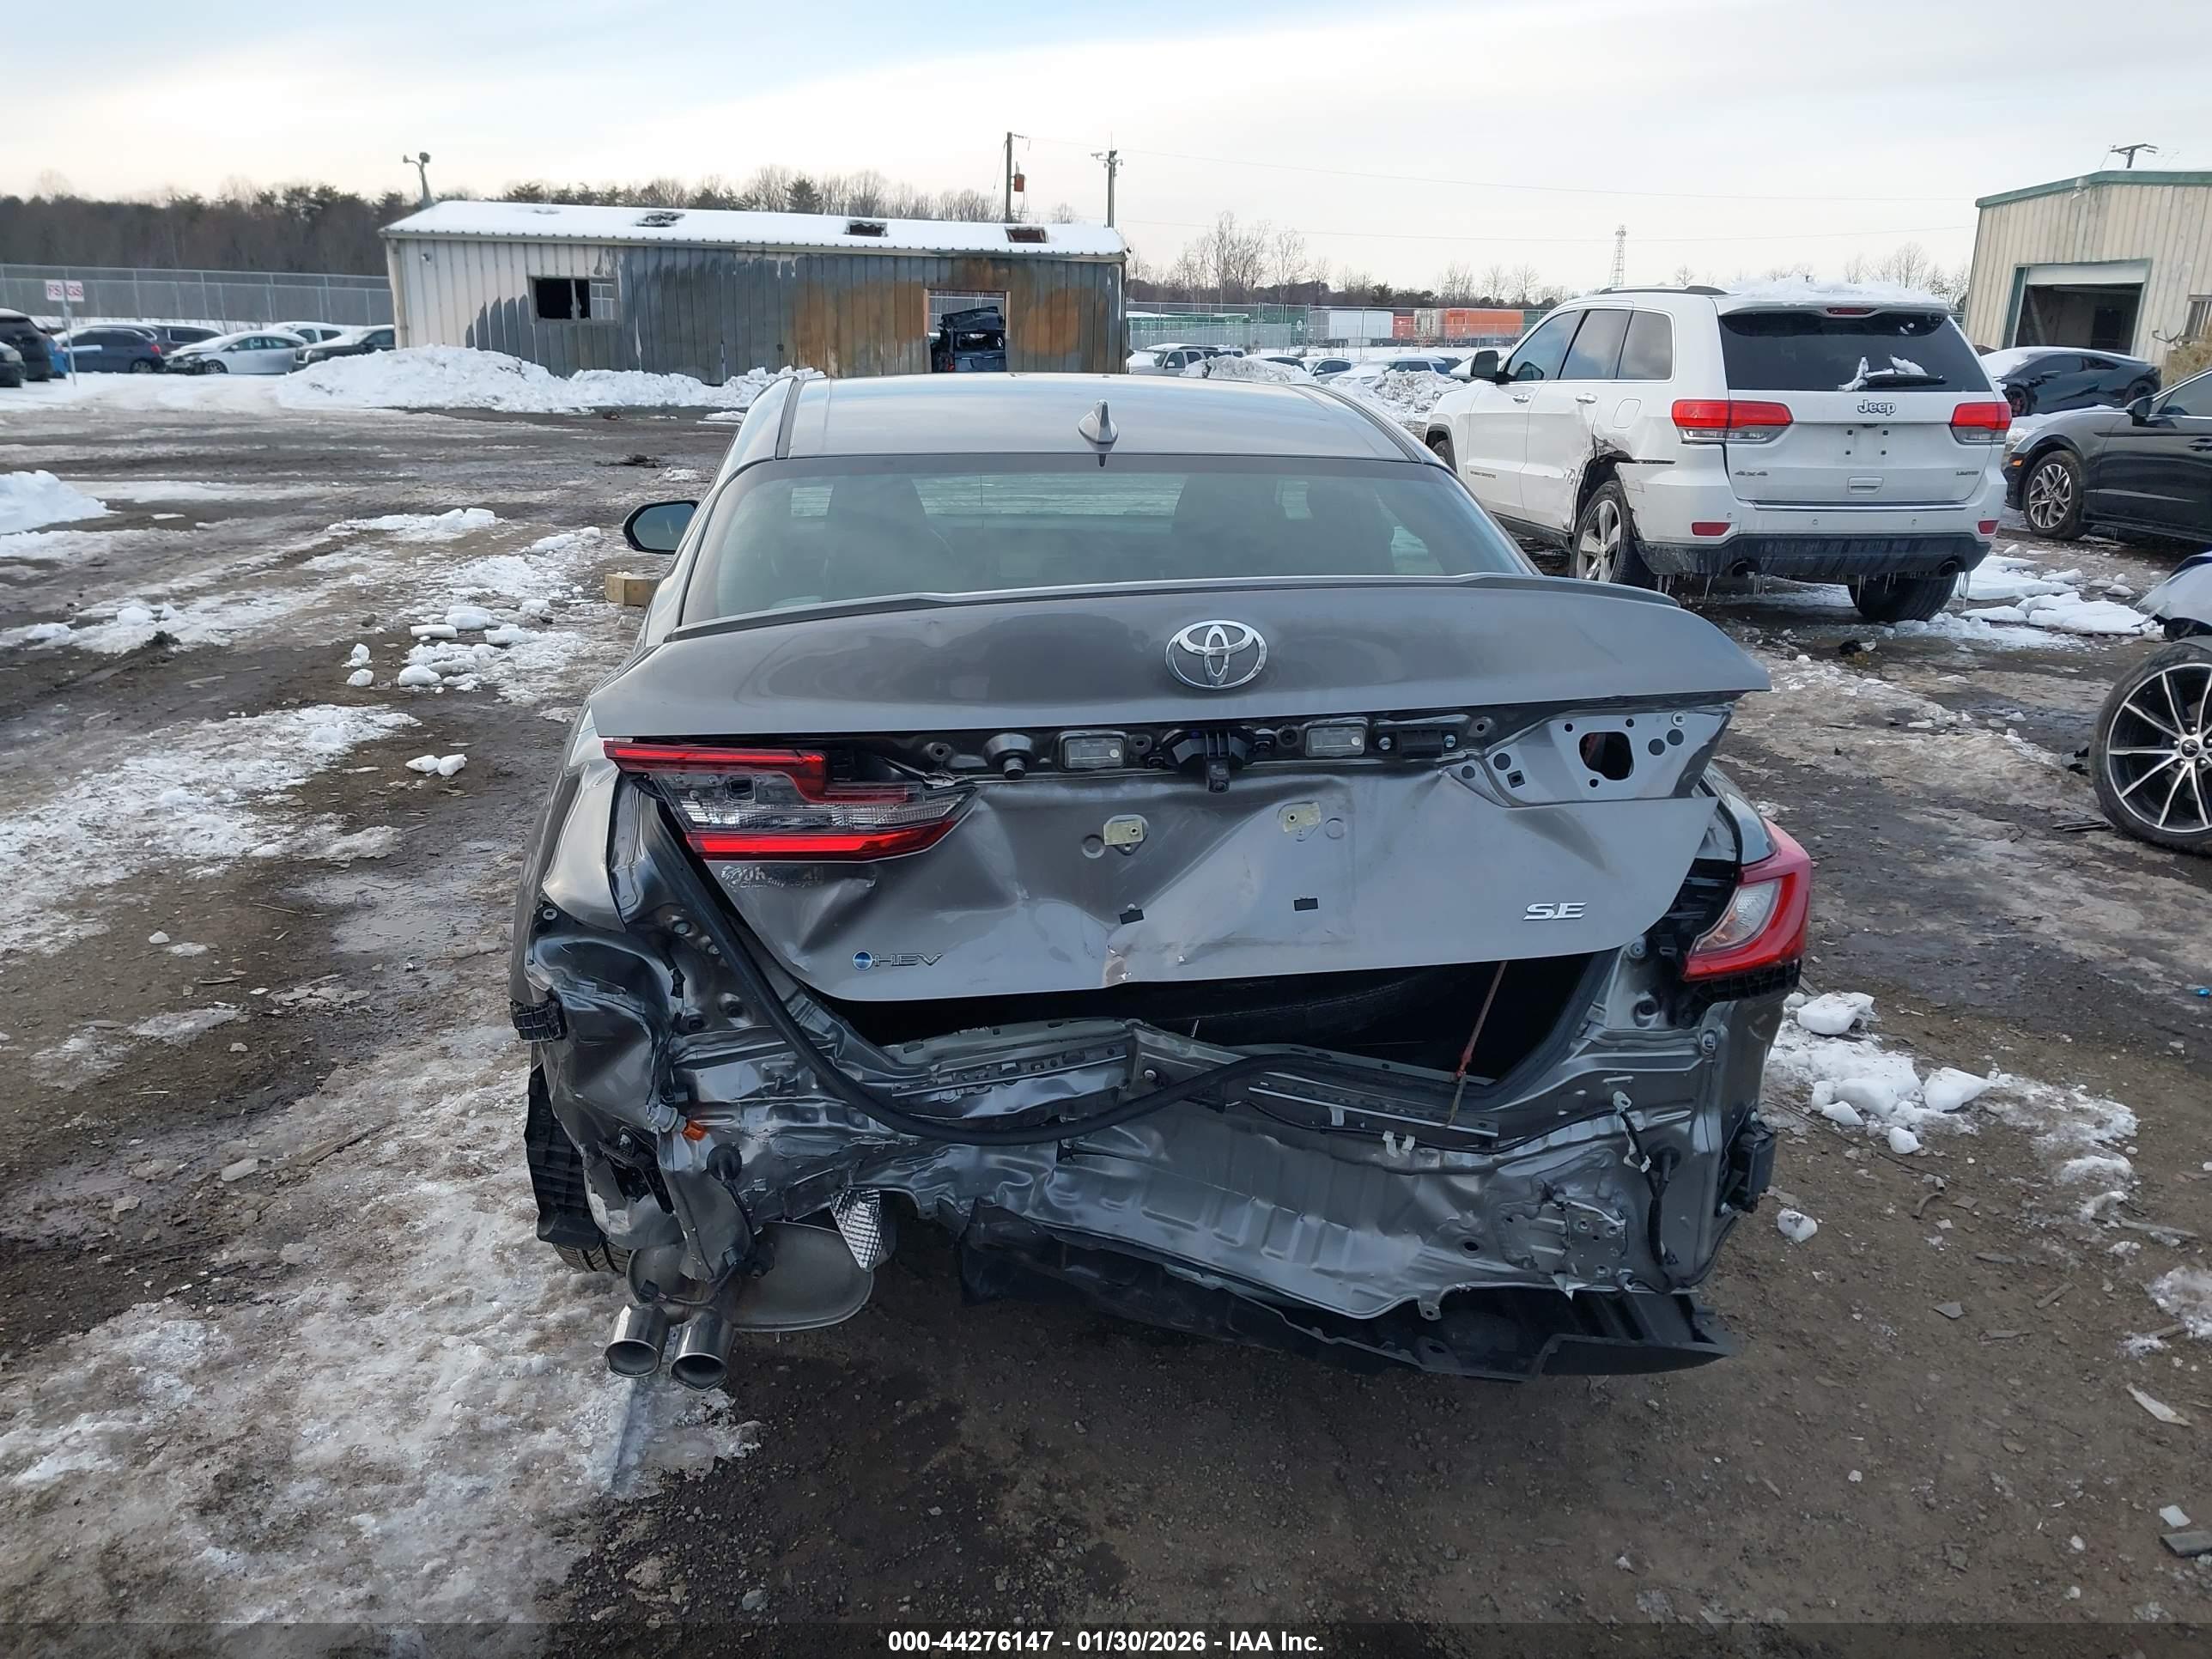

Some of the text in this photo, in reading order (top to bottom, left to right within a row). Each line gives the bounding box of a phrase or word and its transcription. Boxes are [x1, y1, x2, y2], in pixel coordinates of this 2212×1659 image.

[1857, 398, 1897, 416] Jeep
[1522, 902, 1588, 921] SE
[874, 952, 944, 967] HEV
